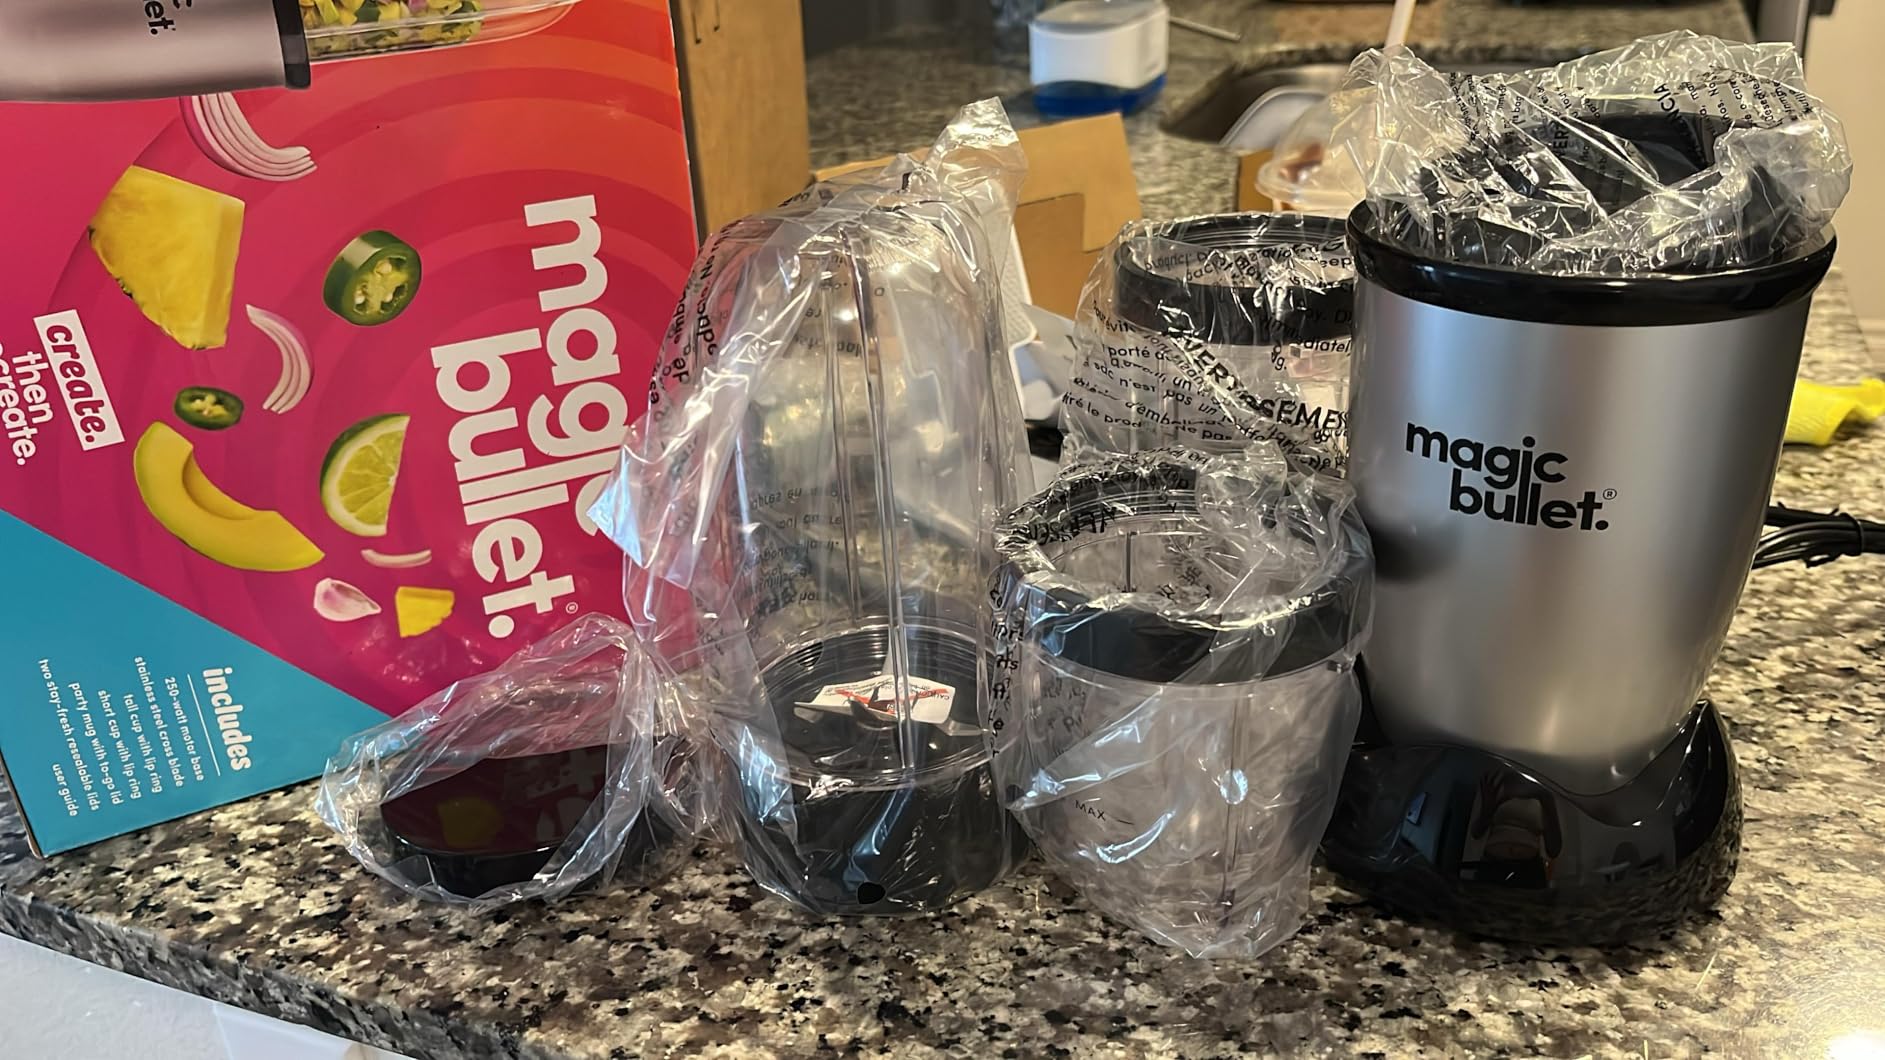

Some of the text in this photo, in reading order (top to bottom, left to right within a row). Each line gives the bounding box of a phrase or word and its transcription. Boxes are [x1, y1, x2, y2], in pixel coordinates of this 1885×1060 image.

[12, 351, 54, 424] then
[46, 325, 106, 443] create.
[1406, 422, 1568, 490] magic
[38, 659, 100, 811] two stay-fresh resealable lids
[68, 682, 124, 805] party mug with to-go lid
[98, 690, 142, 800] short cup with lip ring
[124, 693, 163, 793] tall cup with lip ring
[134, 656, 184, 787] stainless steel cross blade
[164, 676, 205, 781] 250-watt motor base
[203, 667, 252, 770] includes
[52, 764, 79, 817] user guide
[1075, 799, 1106, 821] MAX
